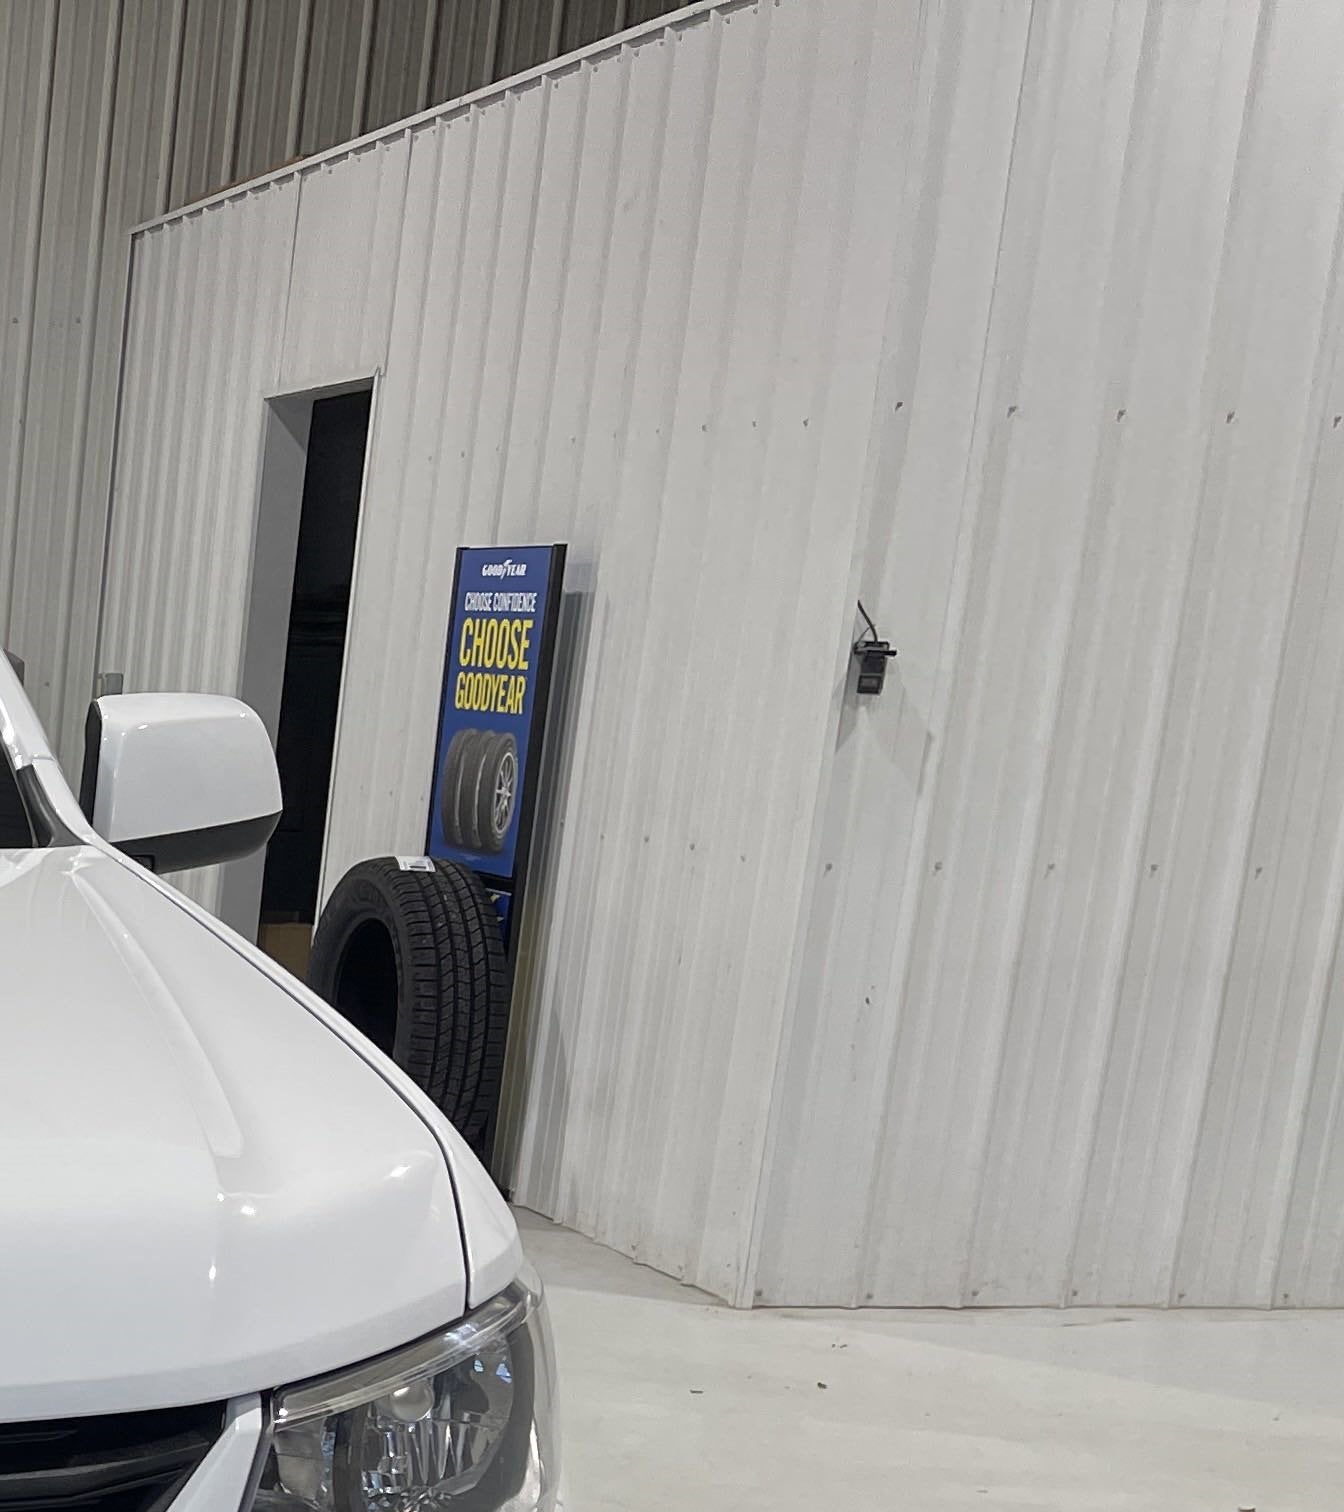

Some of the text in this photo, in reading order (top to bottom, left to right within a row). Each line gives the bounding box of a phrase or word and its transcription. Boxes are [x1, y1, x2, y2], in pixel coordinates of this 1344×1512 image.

[481, 559, 527, 579] GOODYEAR
[464, 592, 538, 612] CHOOSE CONFIDENCE
[459, 617, 534, 670] CHOOSE
[454, 672, 526, 715] GOODYEAR
